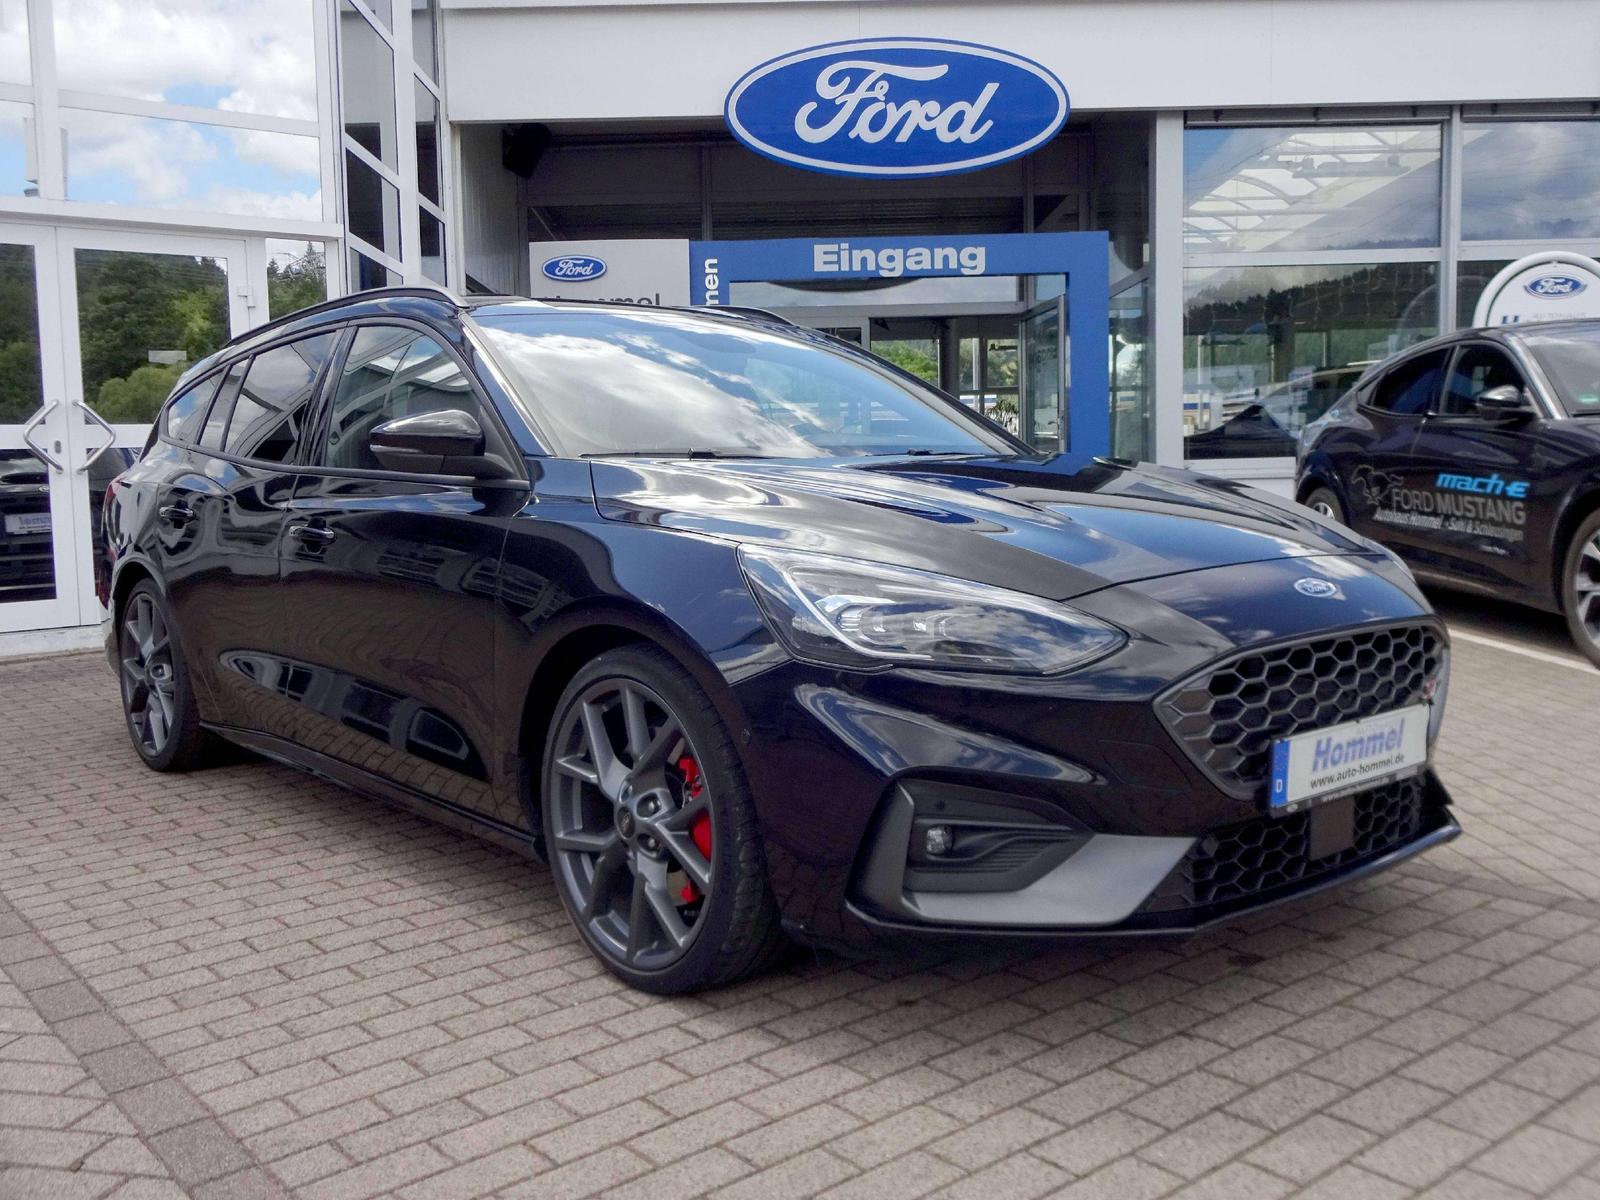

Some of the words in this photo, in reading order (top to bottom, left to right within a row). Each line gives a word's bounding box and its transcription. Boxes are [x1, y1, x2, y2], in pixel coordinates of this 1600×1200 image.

[795, 60, 999, 143] Ford
[555, 259, 594, 276] Ford
[813, 243, 986, 278] Eingang
[1536, 278, 1573, 293] Ford
[1392, 488, 1434, 512] FORD
[1436, 492, 1527, 525] MUSTANG
[1312, 717, 1406, 773] Hommel
[1310, 753, 1405, 789] www.auto-hommel.de
